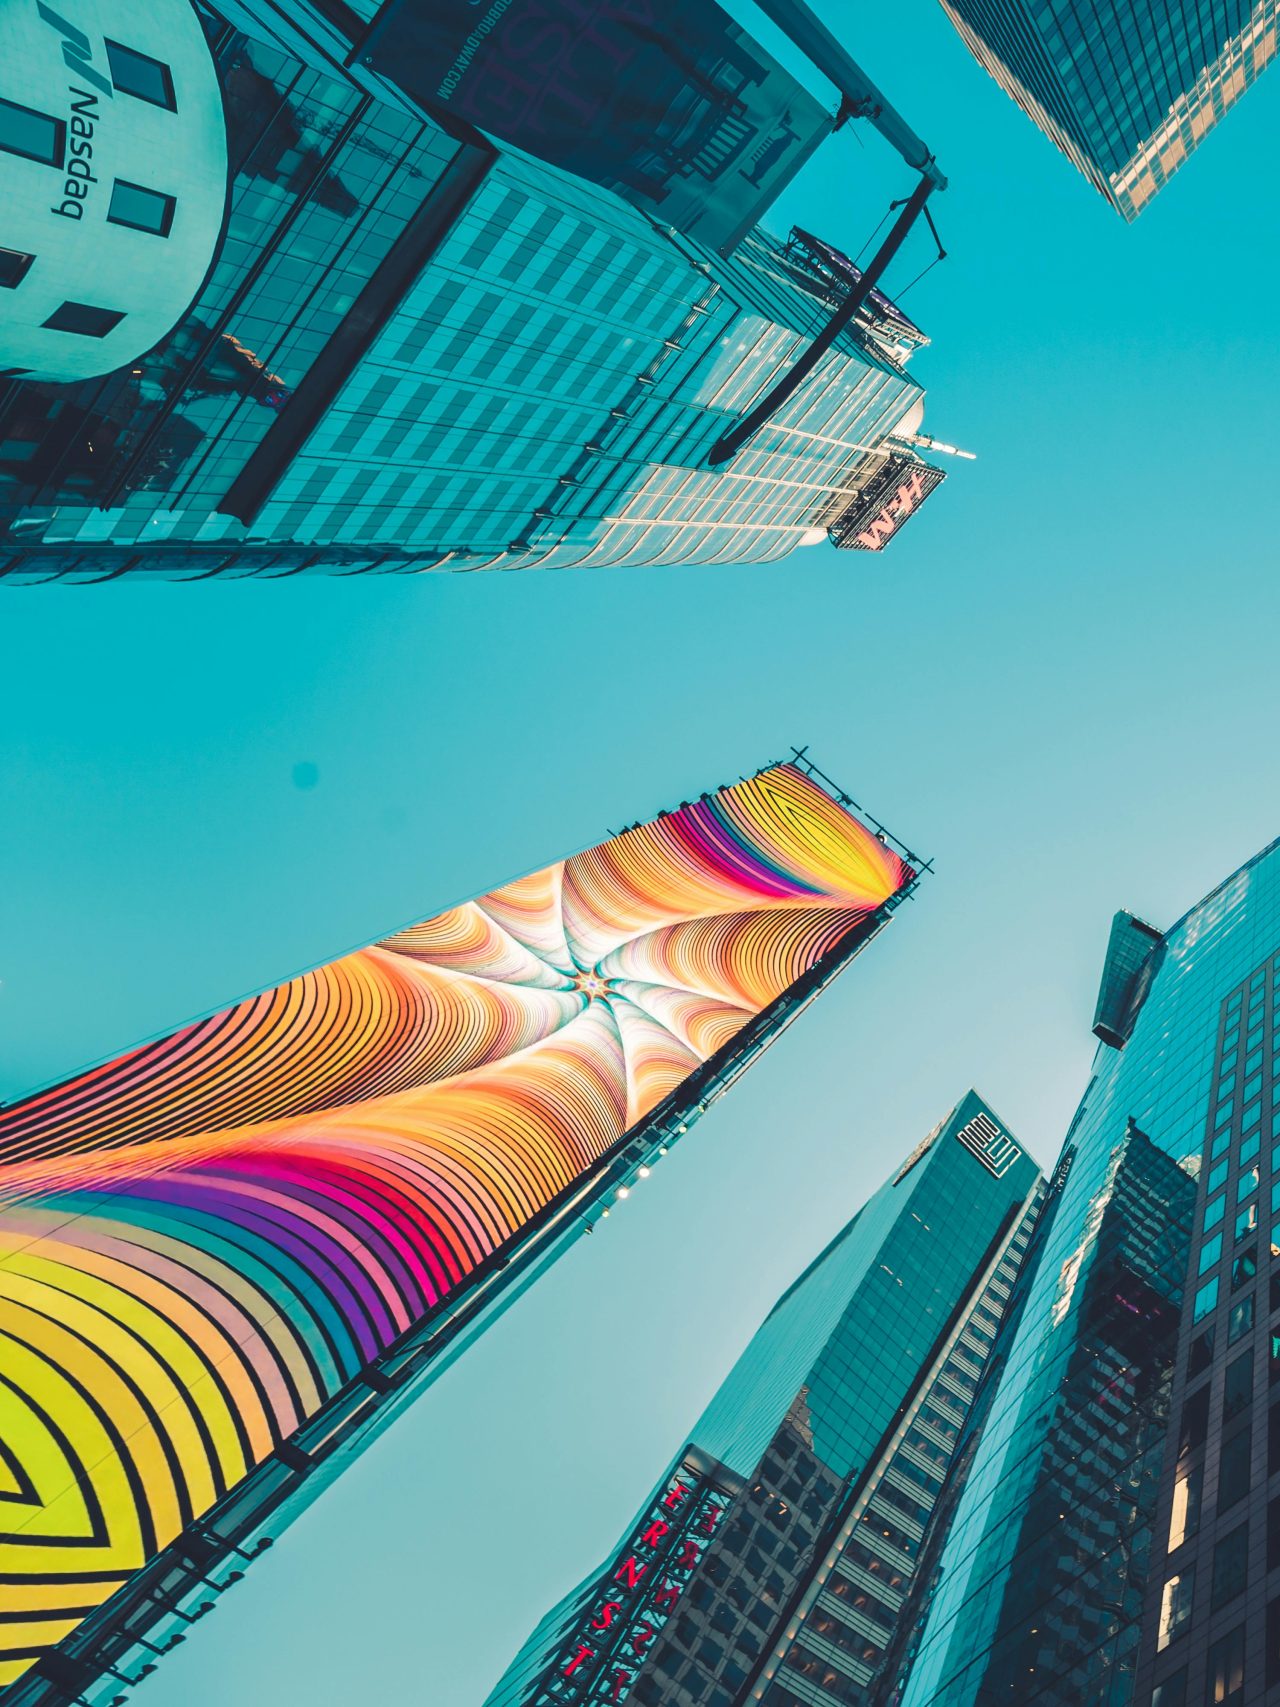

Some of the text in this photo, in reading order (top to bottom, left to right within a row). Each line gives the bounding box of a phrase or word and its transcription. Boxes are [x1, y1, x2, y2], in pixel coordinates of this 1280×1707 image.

[50, 86, 99, 221] Nasdaq
[857, 472, 927, 550] H&M
[563, 1484, 690, 1677] ERNST
